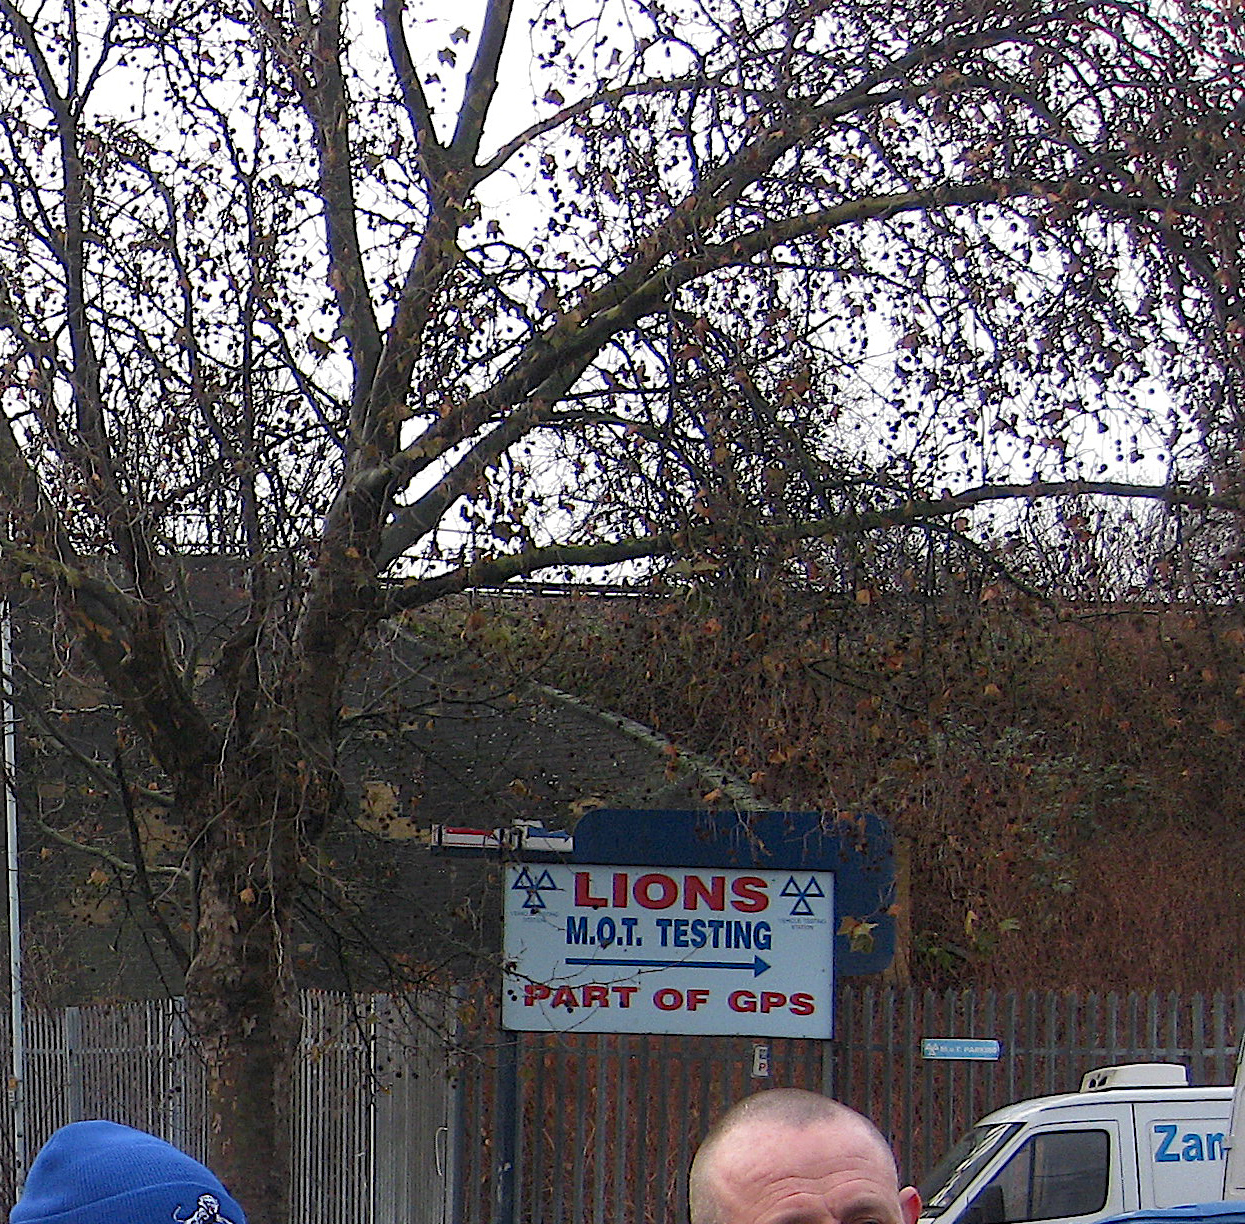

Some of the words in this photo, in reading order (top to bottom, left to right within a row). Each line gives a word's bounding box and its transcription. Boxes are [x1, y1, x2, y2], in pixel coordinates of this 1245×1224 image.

[574, 871, 770, 914] LIONS
[566, 915, 643, 949] M.O.T.
[655, 918, 772, 951] TESTING
[523, 984, 638, 1009] PART
[652, 988, 710, 1012] OF
[727, 990, 815, 1017] GPS
